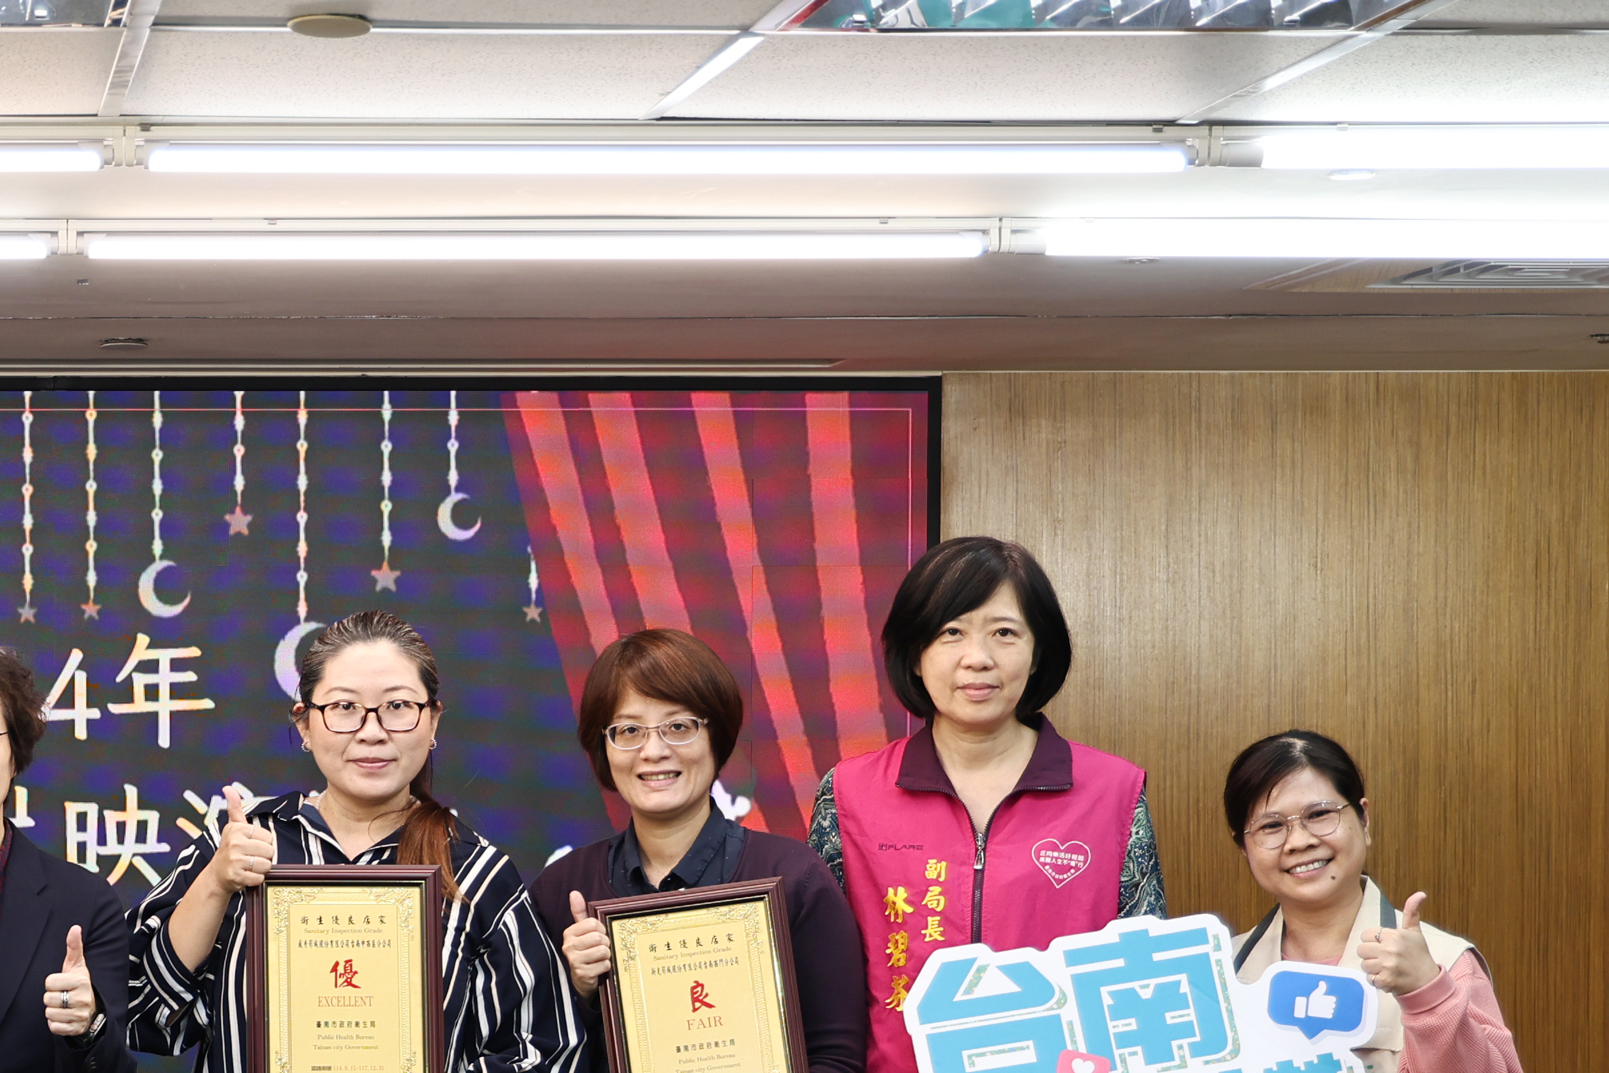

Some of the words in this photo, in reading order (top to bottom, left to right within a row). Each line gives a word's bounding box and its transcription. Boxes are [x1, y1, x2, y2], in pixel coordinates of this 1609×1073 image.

[921, 858, 947, 942] 副局長
[301, 915, 386, 925] 衛生優良店家
[649, 933, 734, 953] 衛生優良店家
[653, 953, 678, 961] Sanitary
[680, 949, 711, 958] Inspection
[330, 959, 361, 989] 優
[318, 995, 374, 1007] EXCELLENT
[690, 980, 716, 1013] 良
[687, 1015, 724, 1031] FAIR
